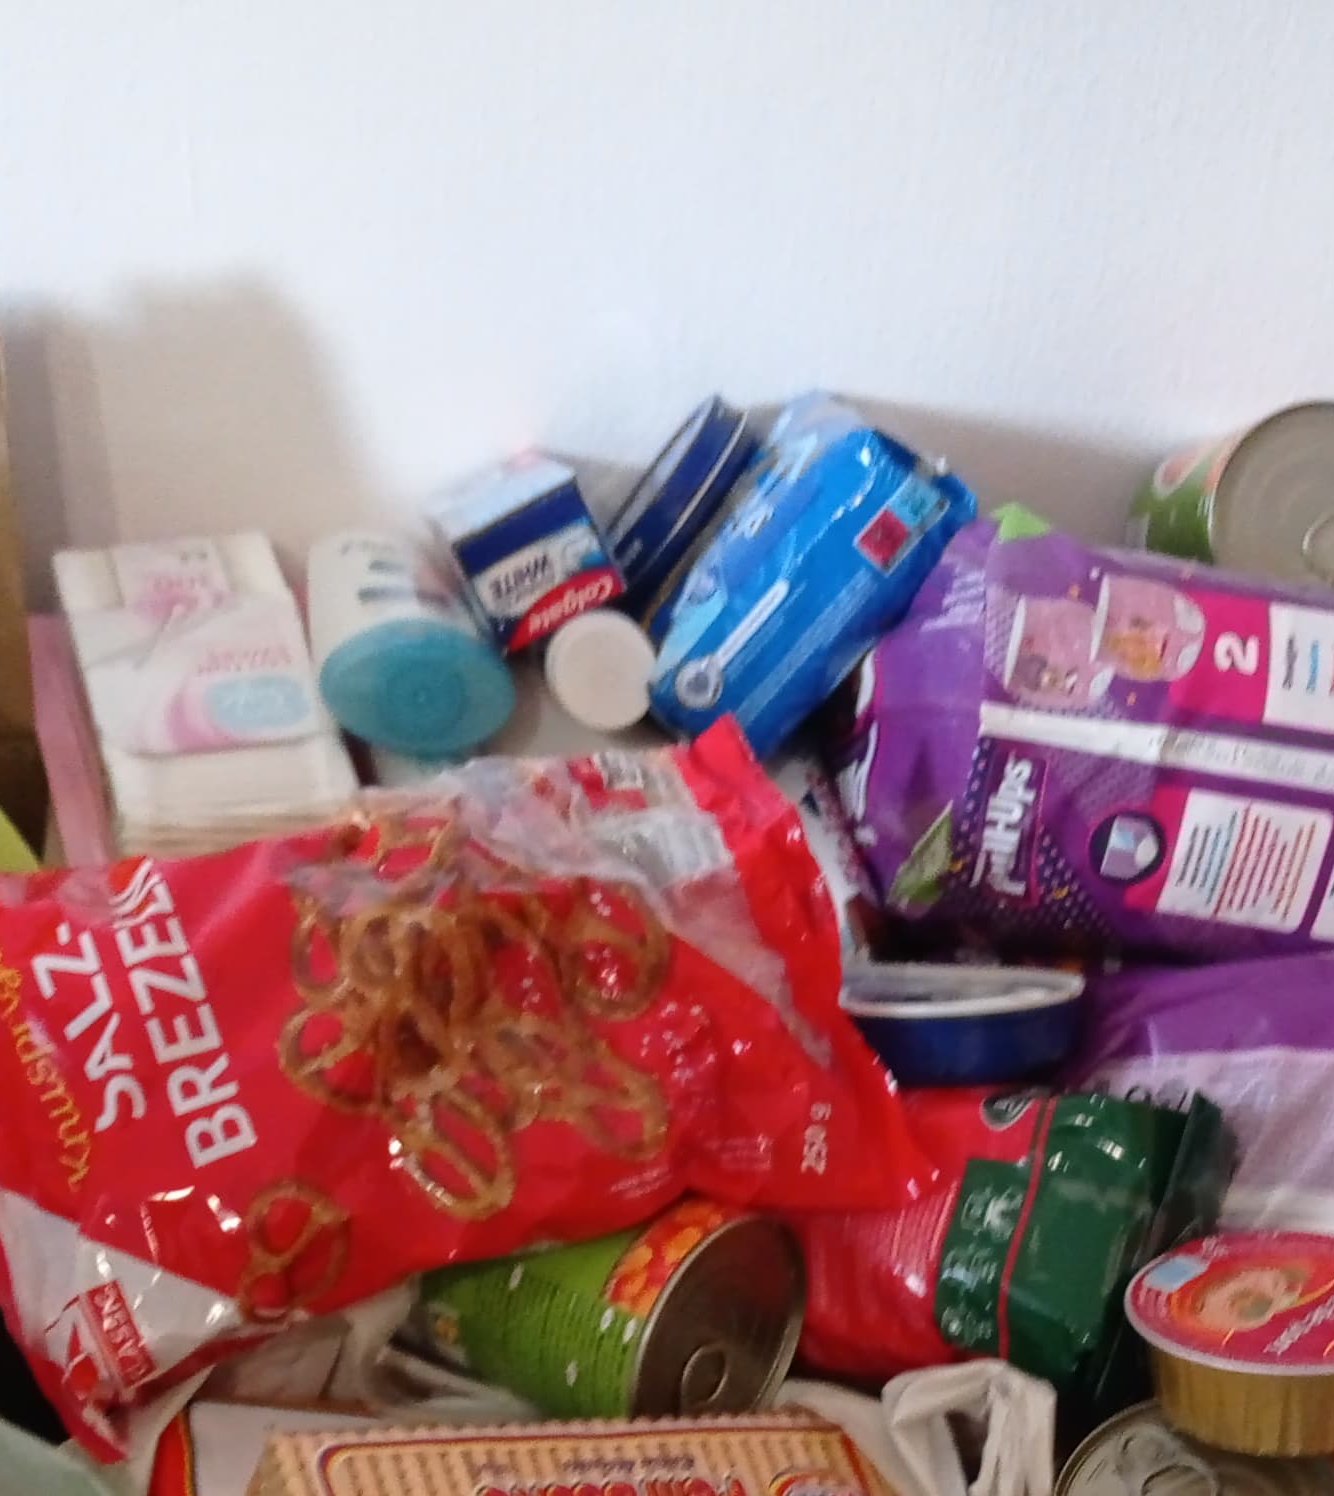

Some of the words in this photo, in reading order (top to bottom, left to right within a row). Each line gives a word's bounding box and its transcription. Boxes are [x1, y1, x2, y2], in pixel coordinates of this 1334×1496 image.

[529, 576, 616, 635] Colgate
[1213, 632, 1260, 676] 2
[30, 924, 147, 1133] SALZ-
